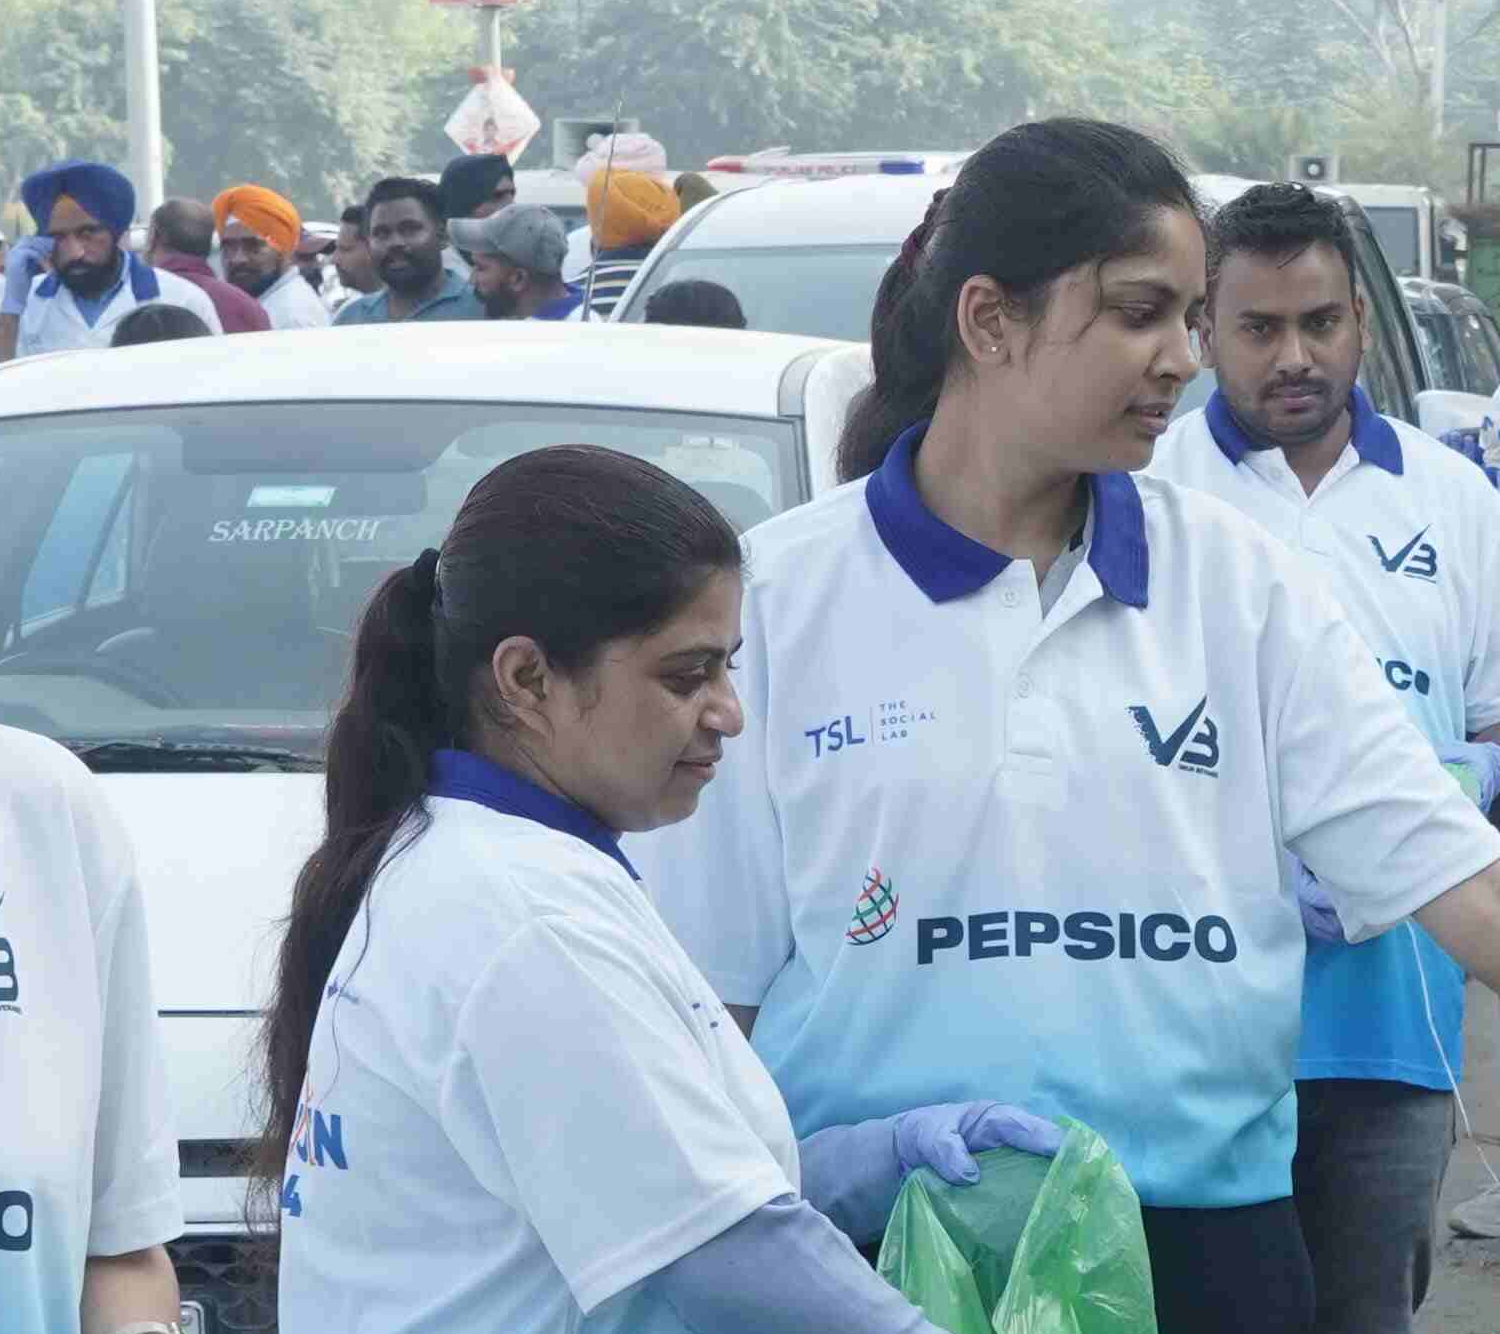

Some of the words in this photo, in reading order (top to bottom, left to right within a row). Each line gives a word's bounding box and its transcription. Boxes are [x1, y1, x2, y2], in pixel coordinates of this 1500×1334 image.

[208, 518, 380, 542] SARPANCH
[879, 700, 906, 712] THE
[879, 711, 936, 727] SOCIAL
[803, 715, 866, 758] TSL
[881, 729, 908, 742] LAB
[916, 910, 1238, 965] PEPSICO
